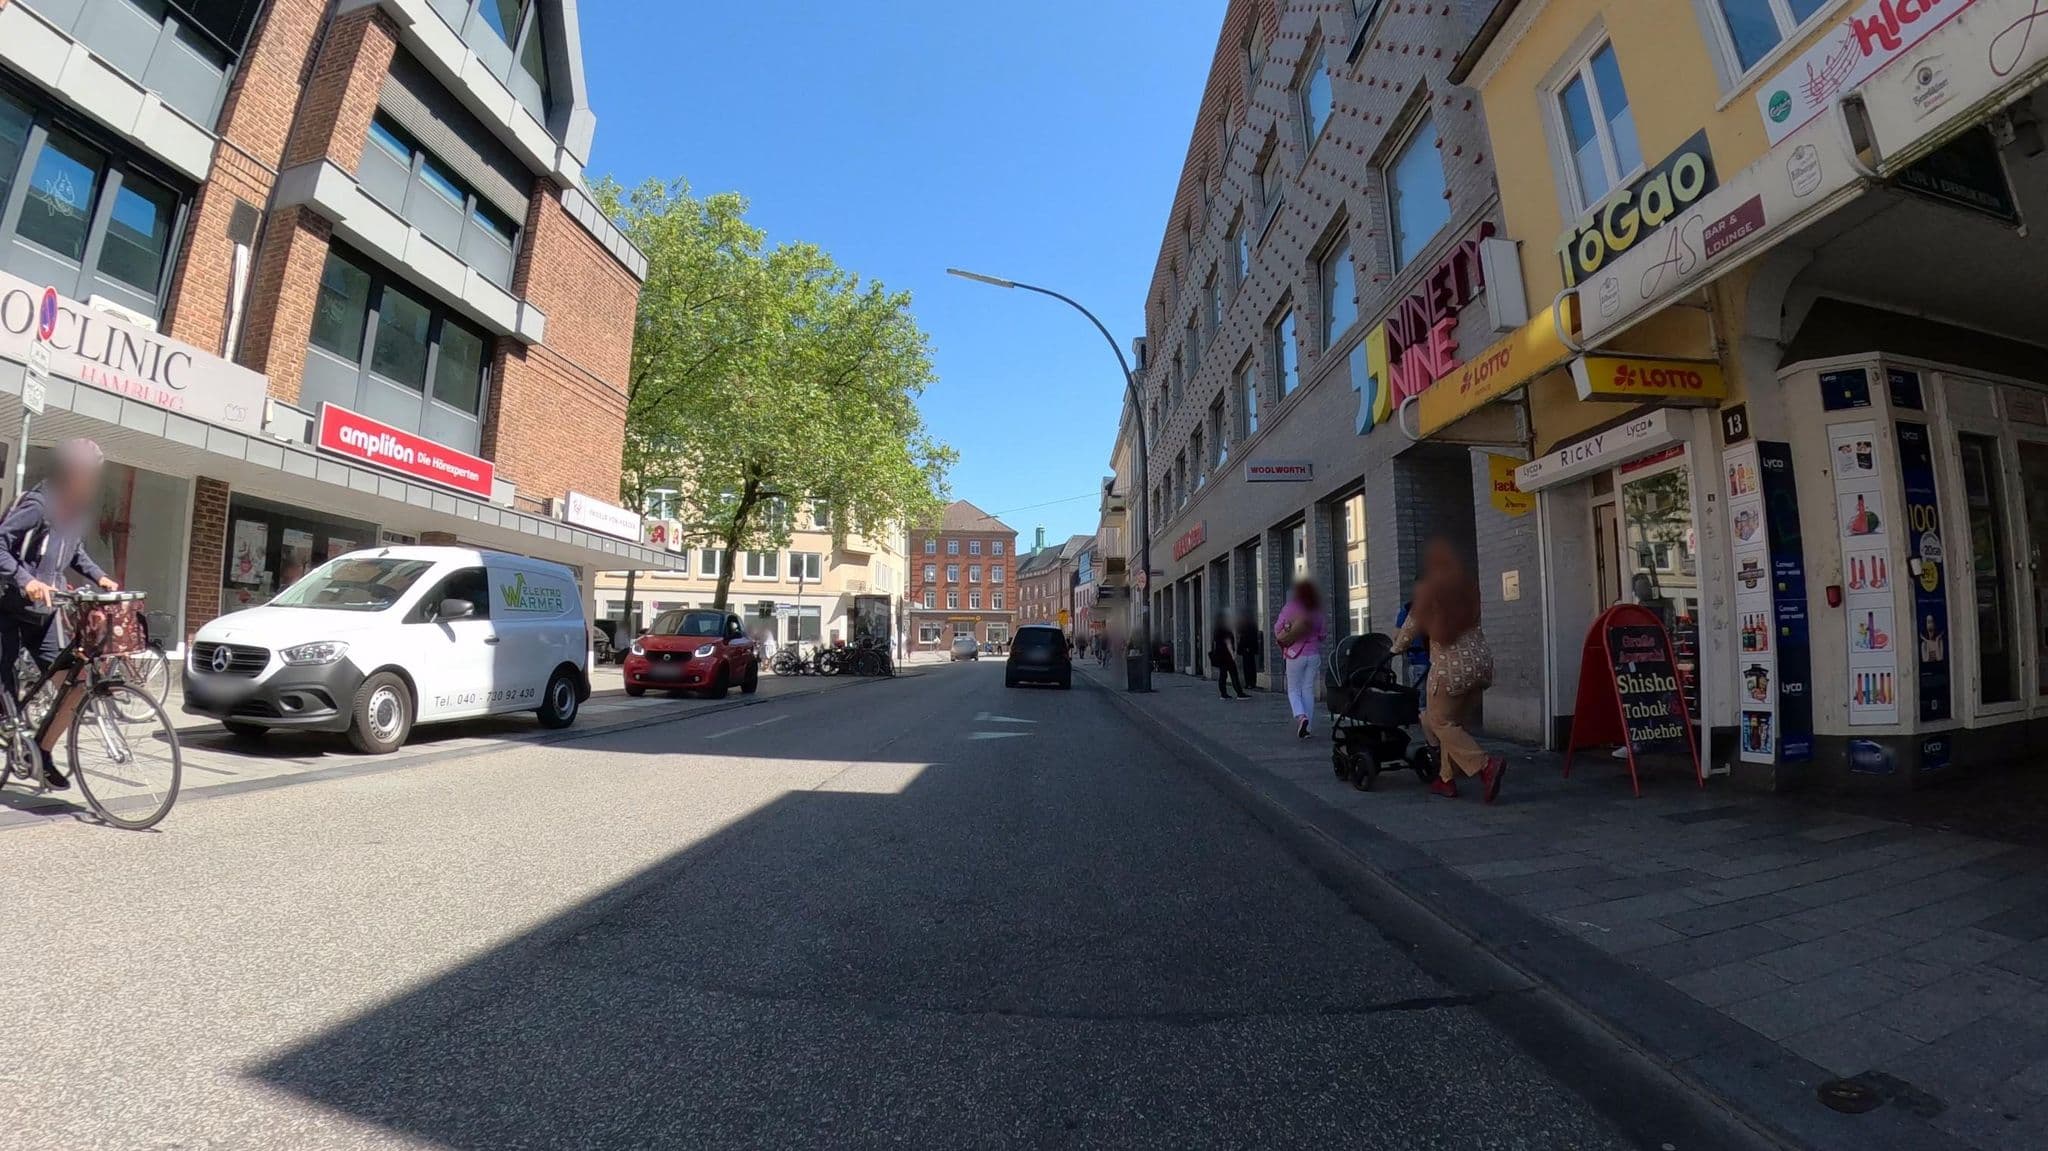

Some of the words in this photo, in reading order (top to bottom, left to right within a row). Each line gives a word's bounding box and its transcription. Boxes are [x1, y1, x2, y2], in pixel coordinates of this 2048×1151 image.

[1704, 221, 1727, 240] BAR
[1729, 214, 1738, 225] &
[1706, 221, 1753, 256] LOUNGE
[1385, 221, 1496, 363] NINETY
[1389, 317, 1464, 411] NINE
[1474, 348, 1510, 386] LOTTO
[1641, 369, 1703, 390] LOTTO
[1626, 421, 1647, 438] Lyco
[1726, 413, 1743, 436] 13
[339, 424, 415, 465] amplifon
[417, 451, 432, 466] Die
[432, 456, 480, 482] Hörexperten
[1560, 436, 1606, 467] RICKY
[1250, 466, 1307, 474] WOOLWORTH
[1762, 457, 1784, 469] Lyco
[522, 586, 562, 598] ELEKTRO
[1616, 673, 1678, 694] Shisha
[1781, 681, 1803, 694] Lyco
[434, 696, 453, 708] Tel.
[457, 693, 476, 705] 040
[486, 688, 503, 703] 730
[505, 690, 517, 700] 92
[519, 688, 535, 699] 430
[1622, 700, 1669, 719] Tabak
[1630, 724, 1683, 741] Zubehör
